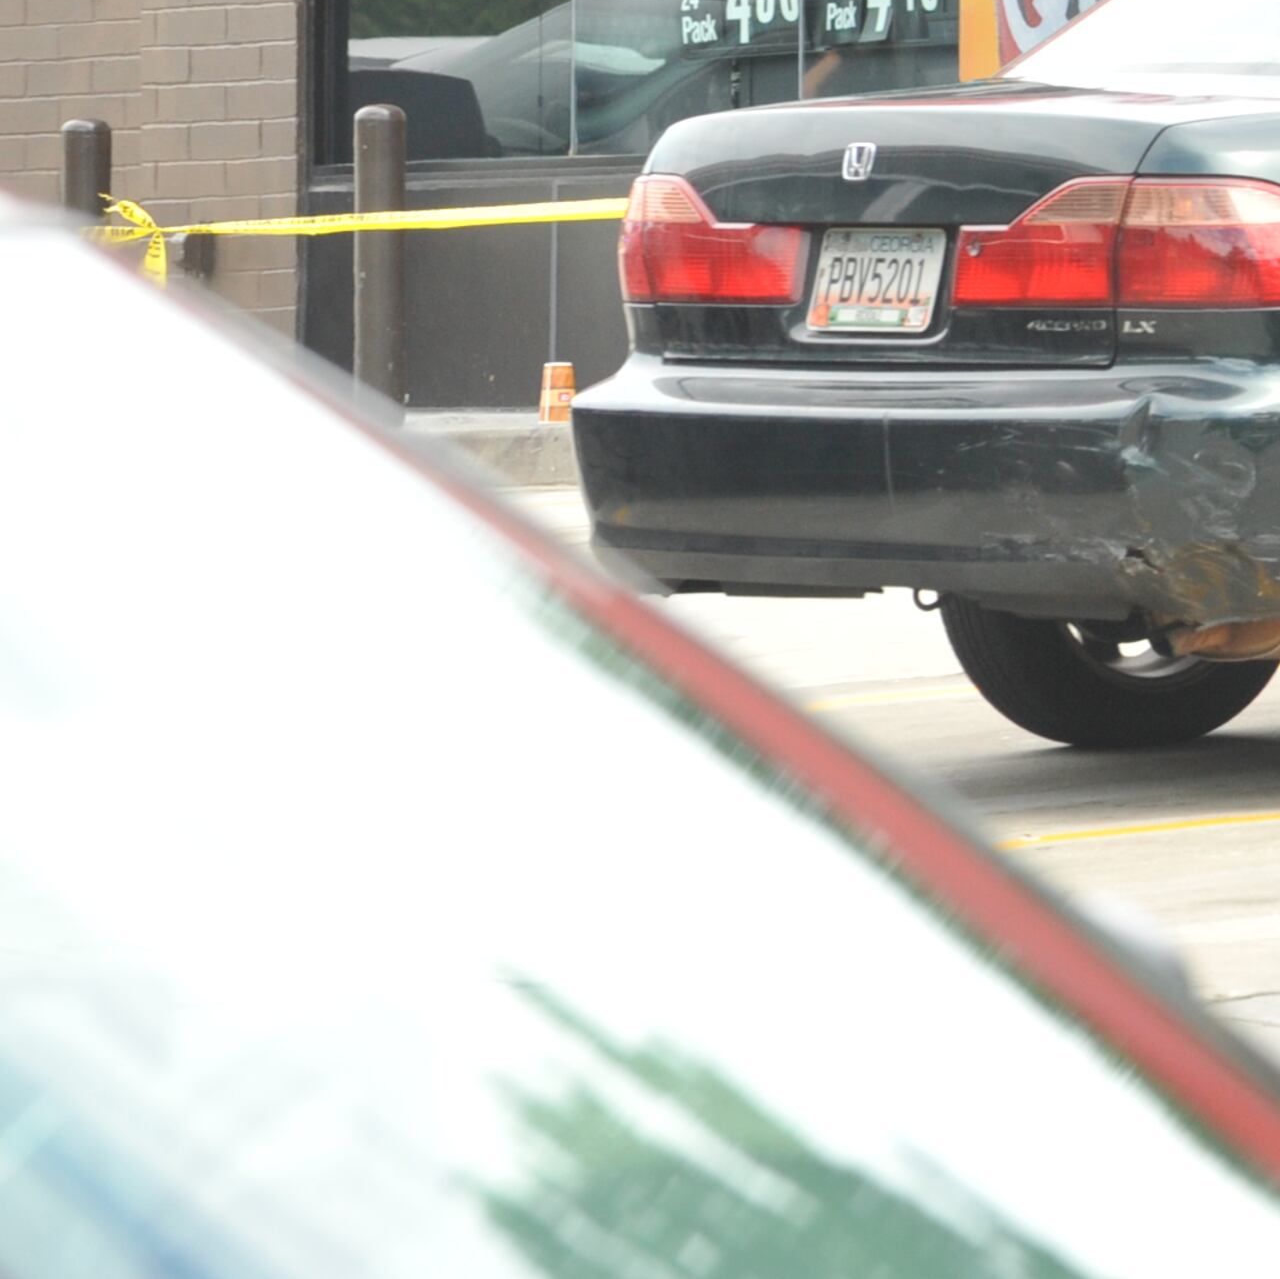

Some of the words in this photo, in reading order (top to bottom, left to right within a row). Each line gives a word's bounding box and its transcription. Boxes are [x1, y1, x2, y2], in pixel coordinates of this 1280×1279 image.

[682, 14, 718, 45] Pack
[826, 0, 856, 31] Pack
[1122, 319, 1158, 334] LX
